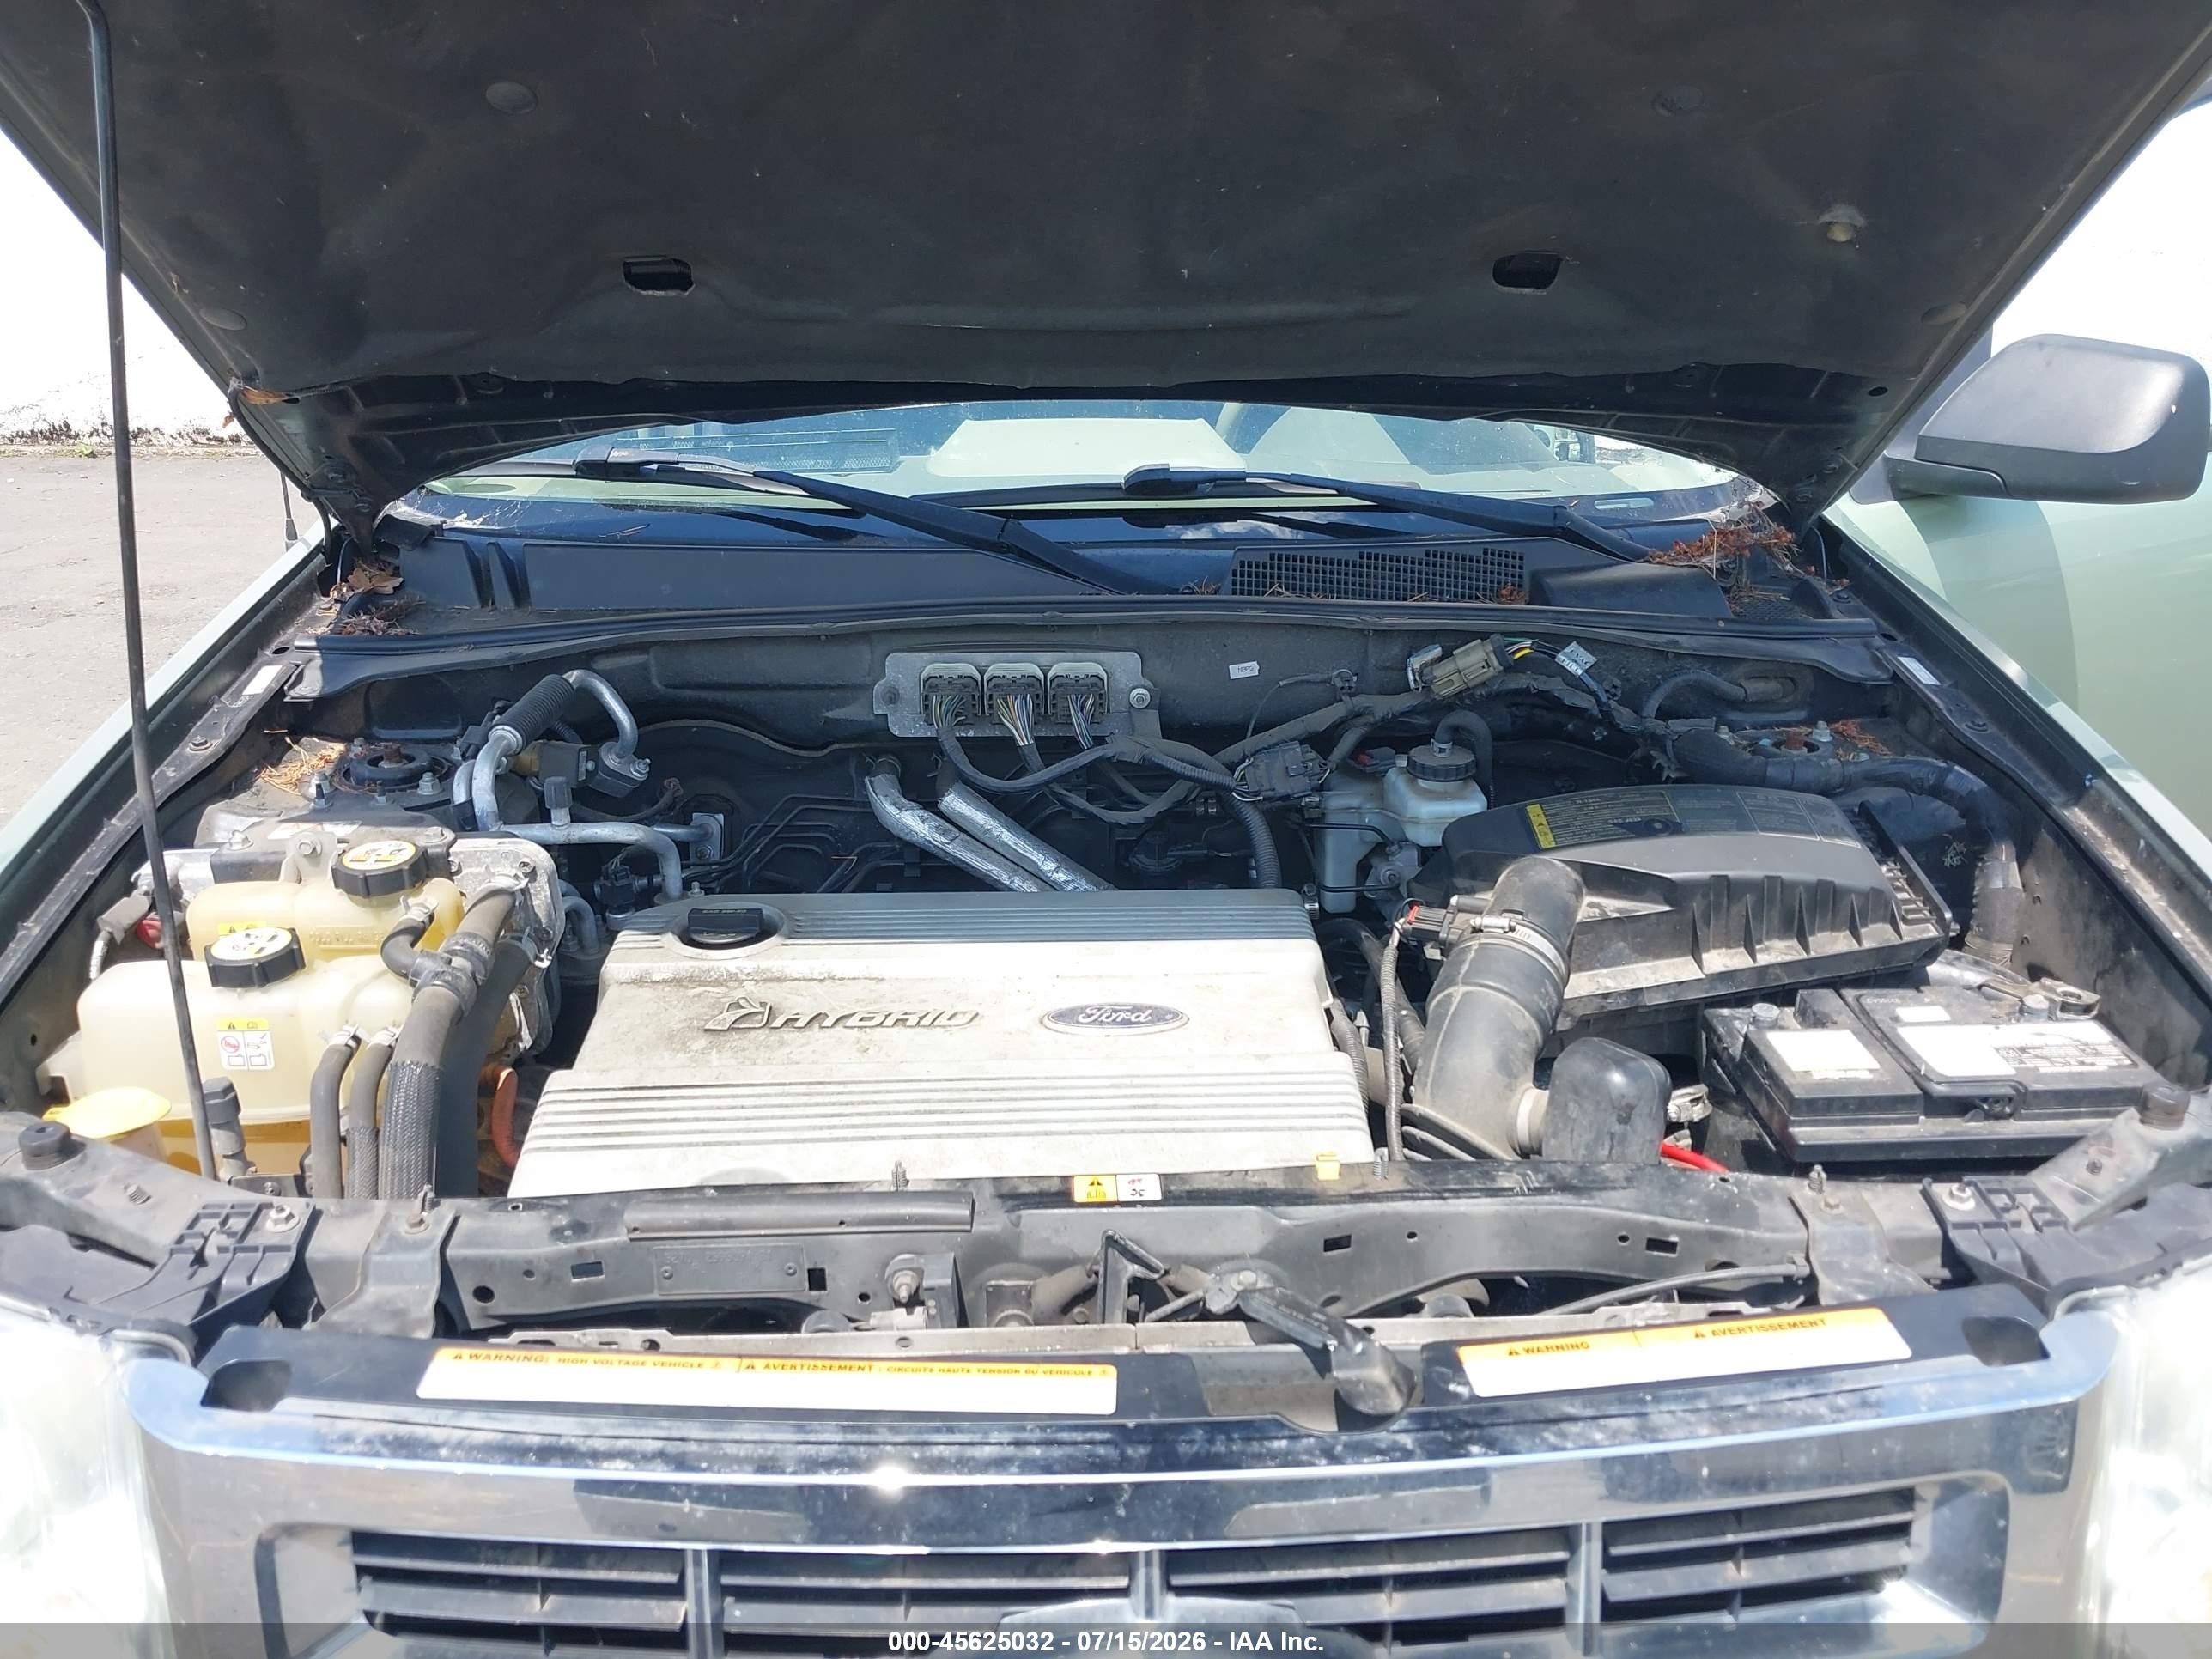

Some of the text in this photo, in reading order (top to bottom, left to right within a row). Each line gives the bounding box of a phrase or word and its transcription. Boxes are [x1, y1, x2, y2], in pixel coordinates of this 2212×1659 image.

[771, 1009, 981, 1029] HYBRID
[1077, 1003, 1153, 1024] Ford
[1711, 1317, 1827, 1337] AVERTISSEMENT
[1522, 1340, 1590, 1353] WARNING
[556, 1357, 589, 1365] HIGH
[592, 1358, 648, 1367] VOLTAGE
[652, 1359, 705, 1370] VEHICLE
[763, 1362, 873, 1372] AVERTISSEMENT
